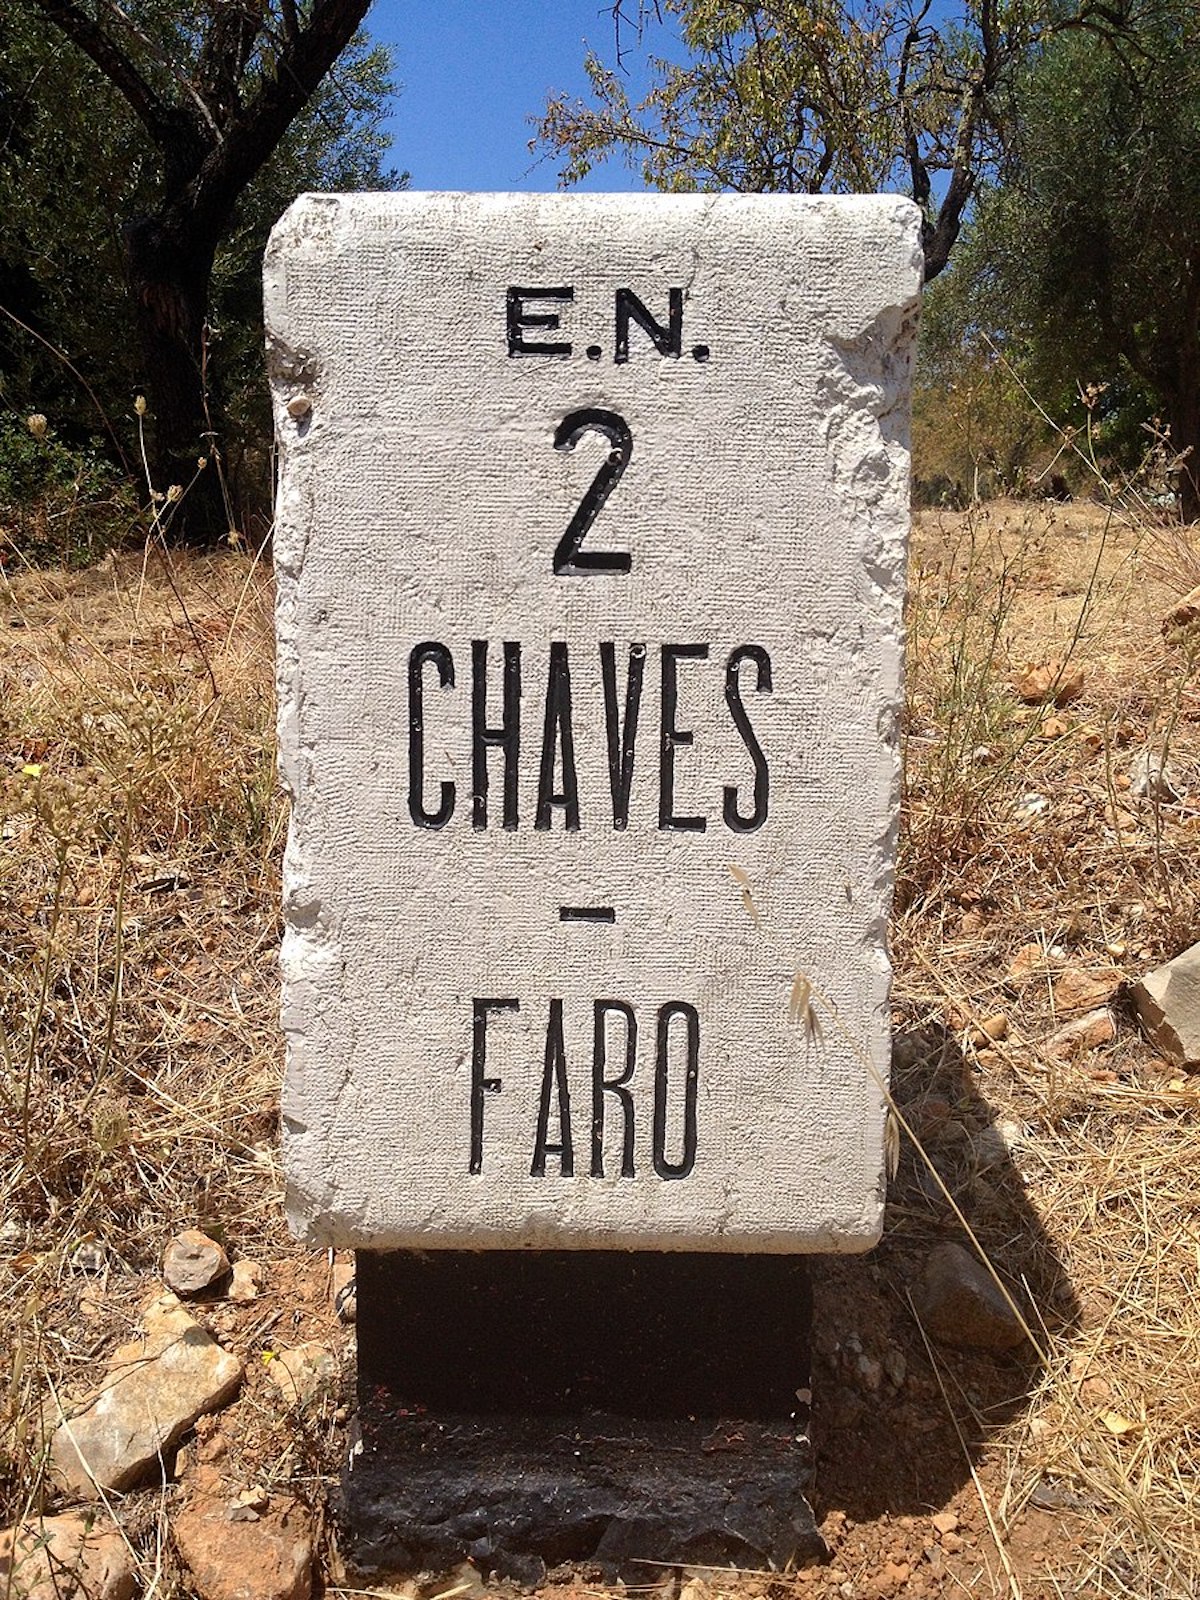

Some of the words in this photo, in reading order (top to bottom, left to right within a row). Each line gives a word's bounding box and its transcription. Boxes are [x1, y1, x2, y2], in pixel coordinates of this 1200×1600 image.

[506, 286, 710, 364] E.N.
[552, 407, 633, 576] 2
[408, 639, 774, 833] CHAVES
[469, 997, 701, 1181] FARO
